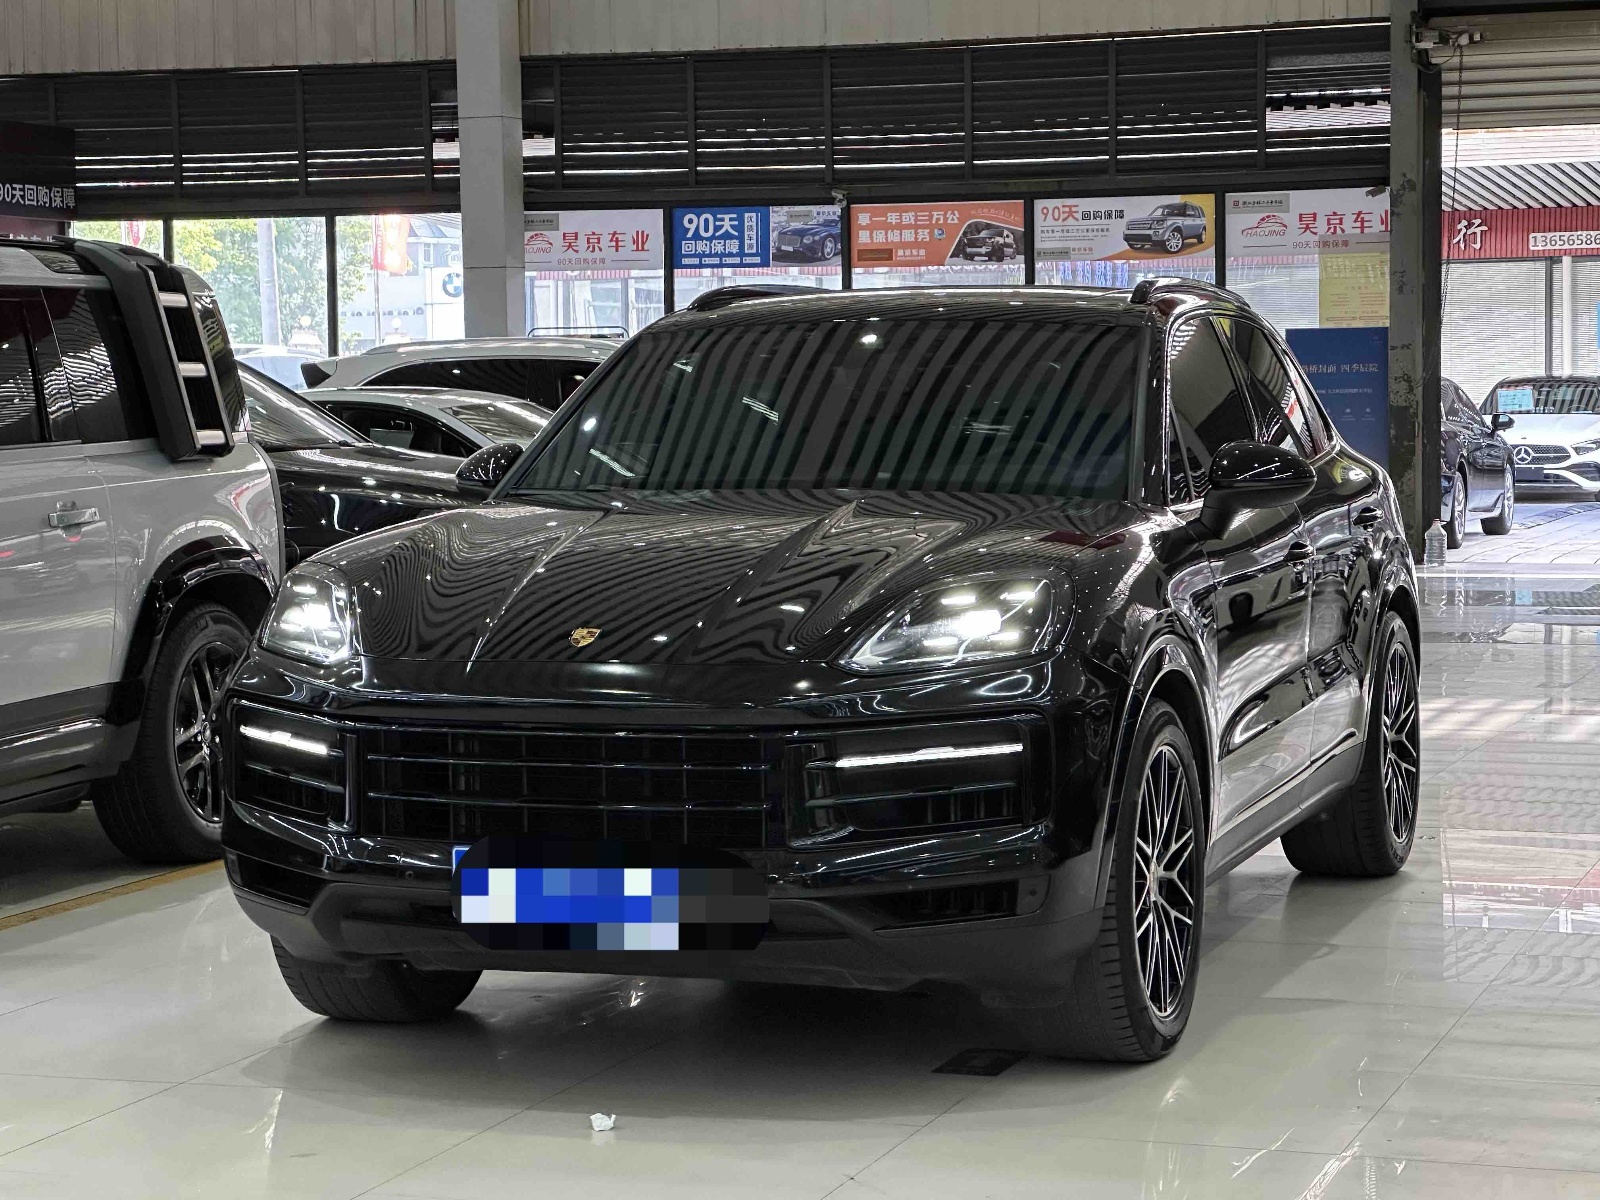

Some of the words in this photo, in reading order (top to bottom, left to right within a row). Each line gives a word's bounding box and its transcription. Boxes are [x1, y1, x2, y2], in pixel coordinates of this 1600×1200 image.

[683, 213, 739, 238] 90天
[857, 210, 960, 226] 享一年或三万公
[857, 229, 930, 244] 里保修服务
[1245, 229, 1287, 238] HAOJING
[1452, 218, 1489, 251] 行
[562, 230, 650, 254] 昊京车业
[682, 239, 740, 255] 回购保障
[1292, 239, 1349, 249] 90天回购保障
[557, 258, 606, 266] 90天回购保障
